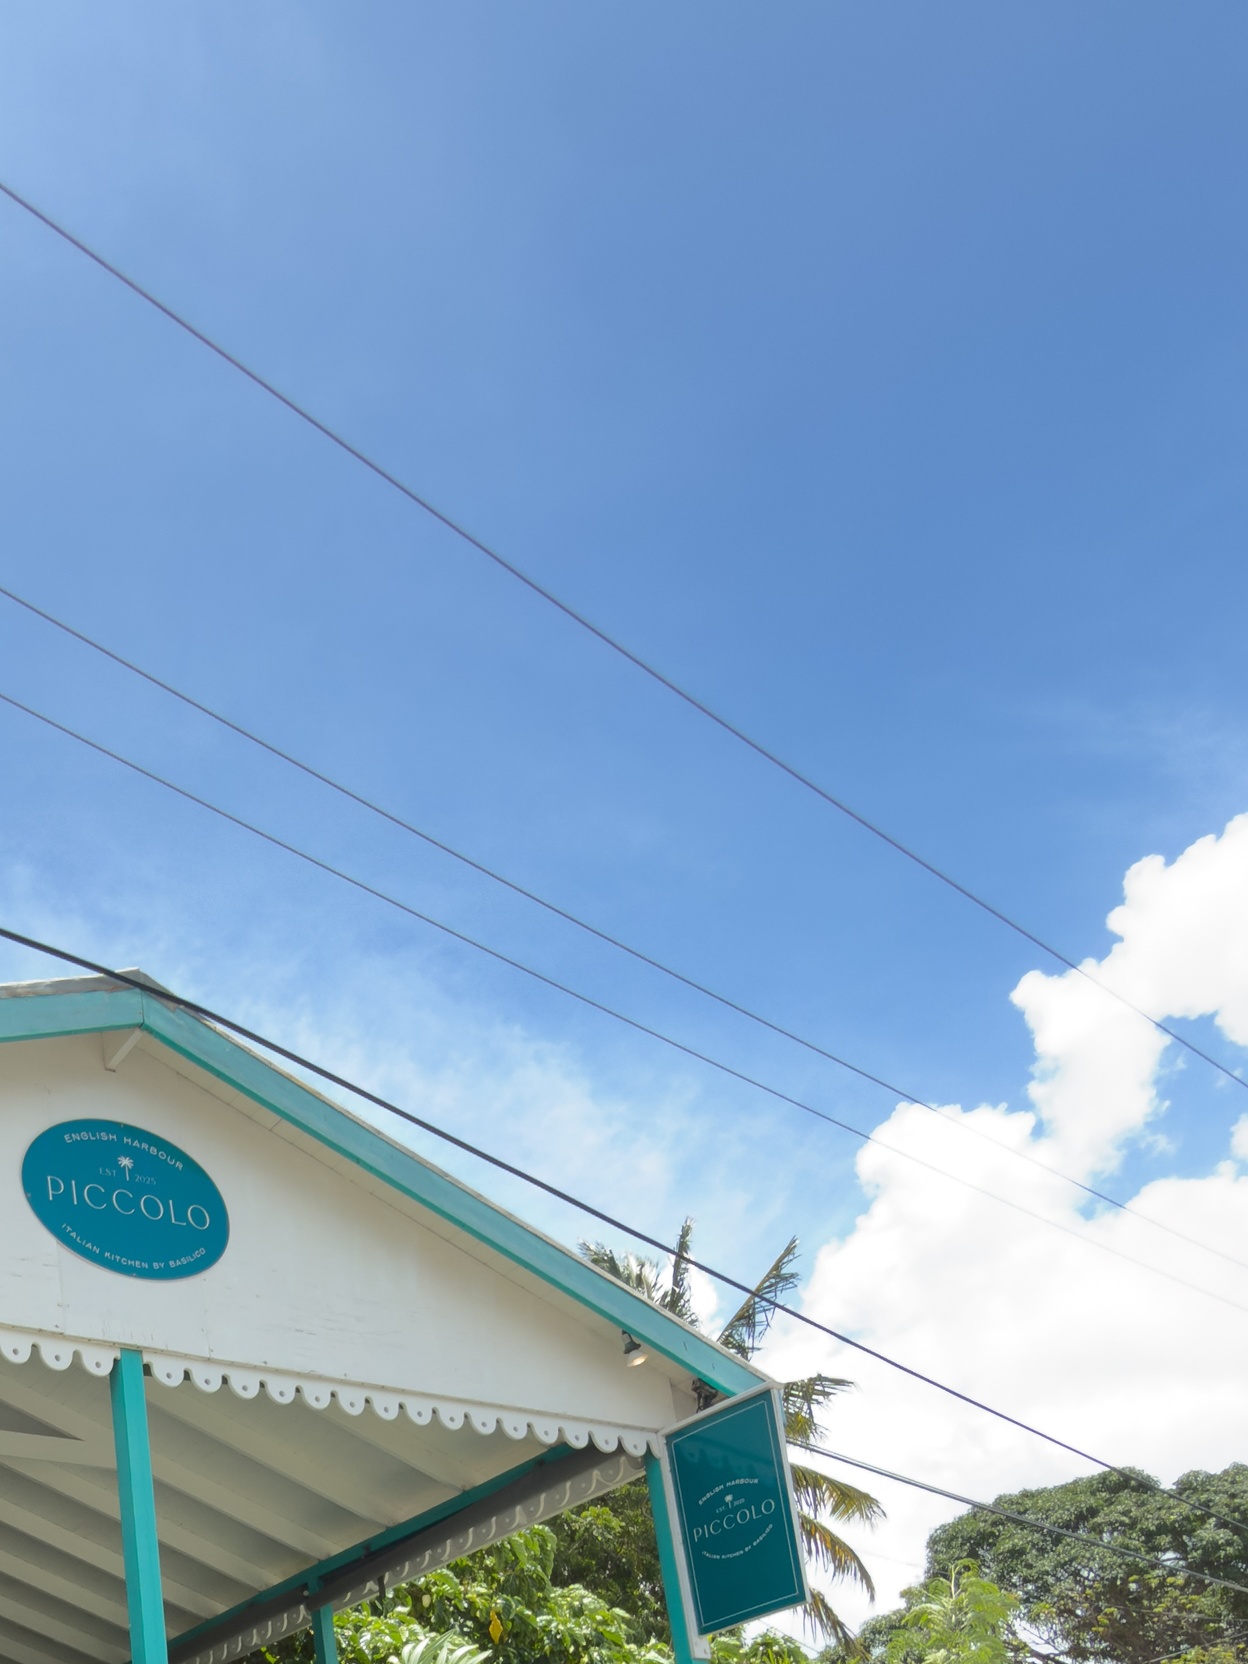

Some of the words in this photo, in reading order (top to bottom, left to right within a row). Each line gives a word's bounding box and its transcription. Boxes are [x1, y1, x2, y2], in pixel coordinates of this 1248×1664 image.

[64, 1131, 117, 1143] ENGLISH
[123, 1136, 184, 1171] HARBOUR
[134, 1174, 157, 1185] 2025
[47, 1175, 210, 1230] PICCOLO
[61, 1223, 100, 1254] ITALIAN
[104, 1251, 149, 1269] KITCHEN
[153, 1262, 165, 1270] BY
[169, 1247, 206, 1268] BASILICO
[698, 1484, 724, 1505] ENGLISH
[726, 1478, 759, 1487] HARBOUR
[693, 1498, 775, 1543] PICCOLO
